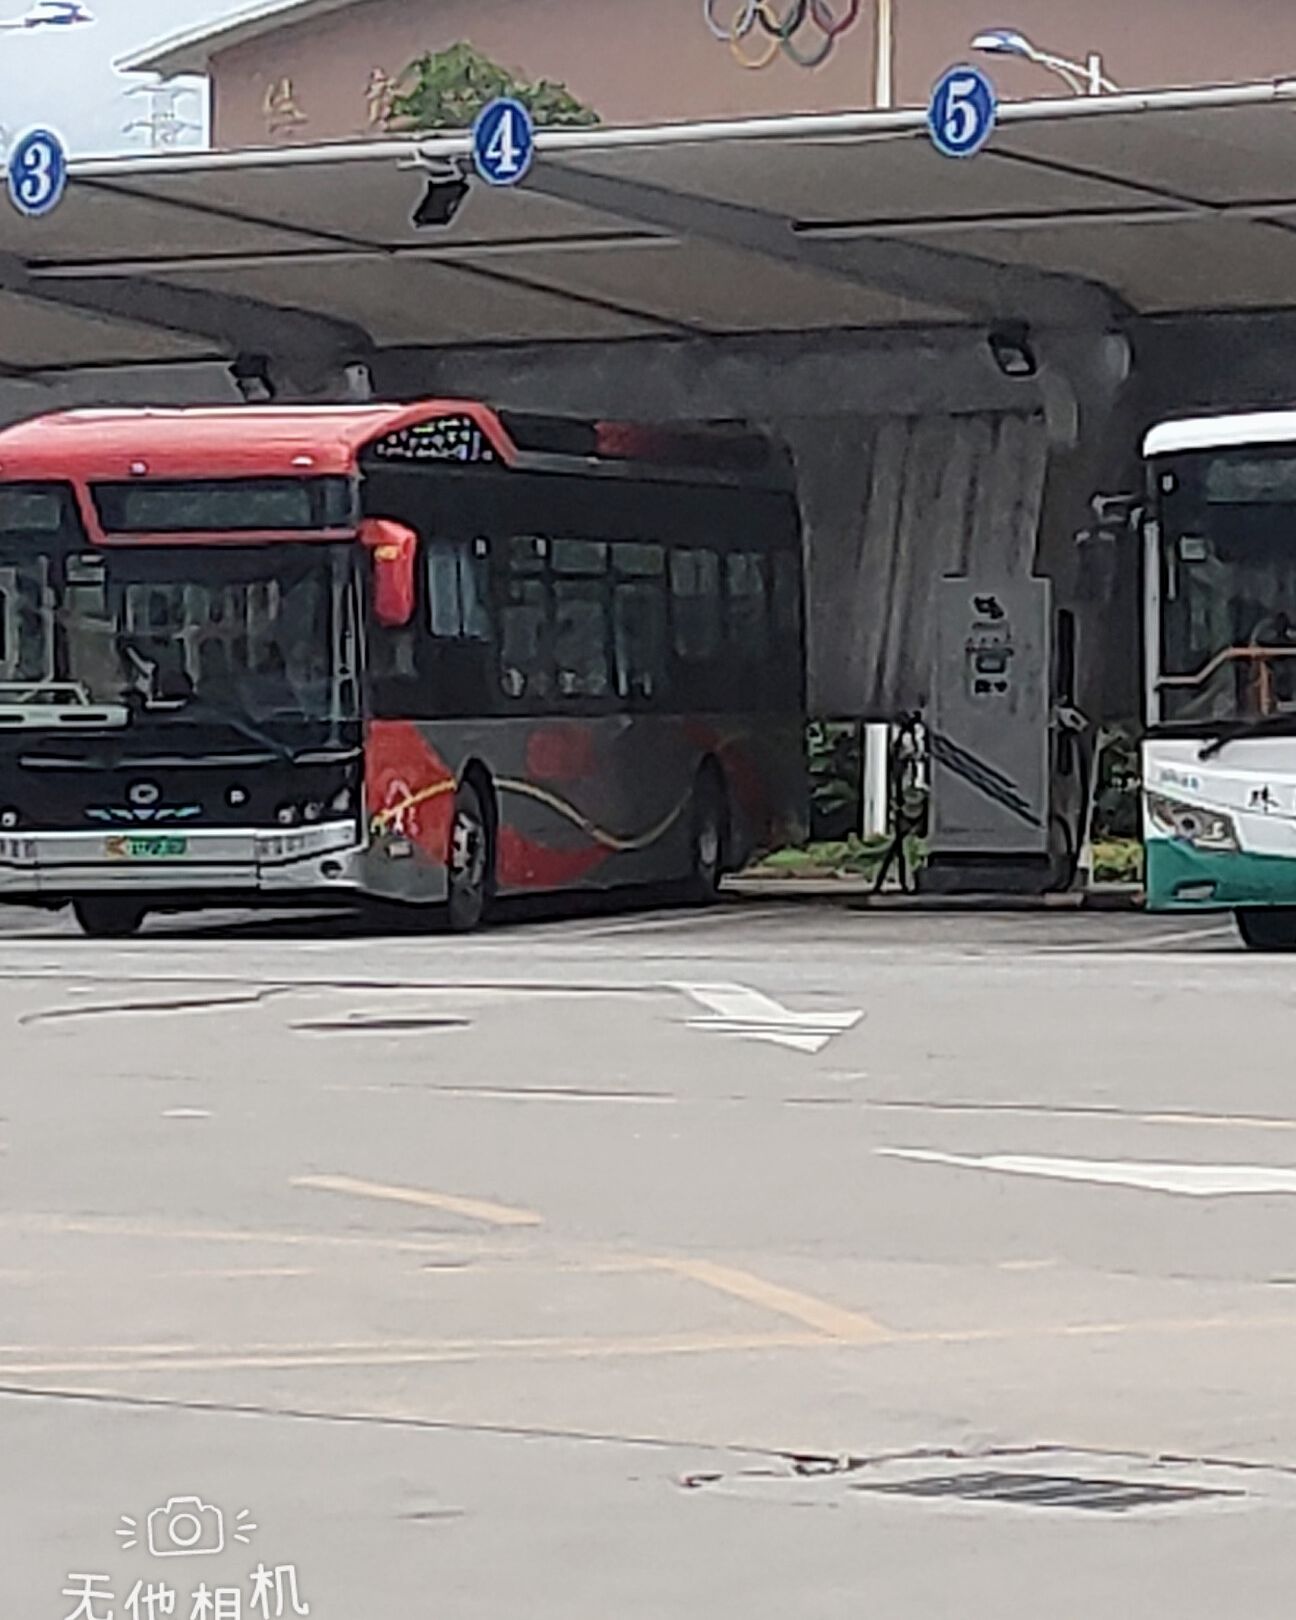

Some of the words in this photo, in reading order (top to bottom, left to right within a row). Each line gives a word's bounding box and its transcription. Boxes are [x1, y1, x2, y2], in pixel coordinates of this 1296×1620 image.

[485, 110, 523, 174] 4
[944, 78, 978, 143] 5
[20, 142, 52, 204] 3
